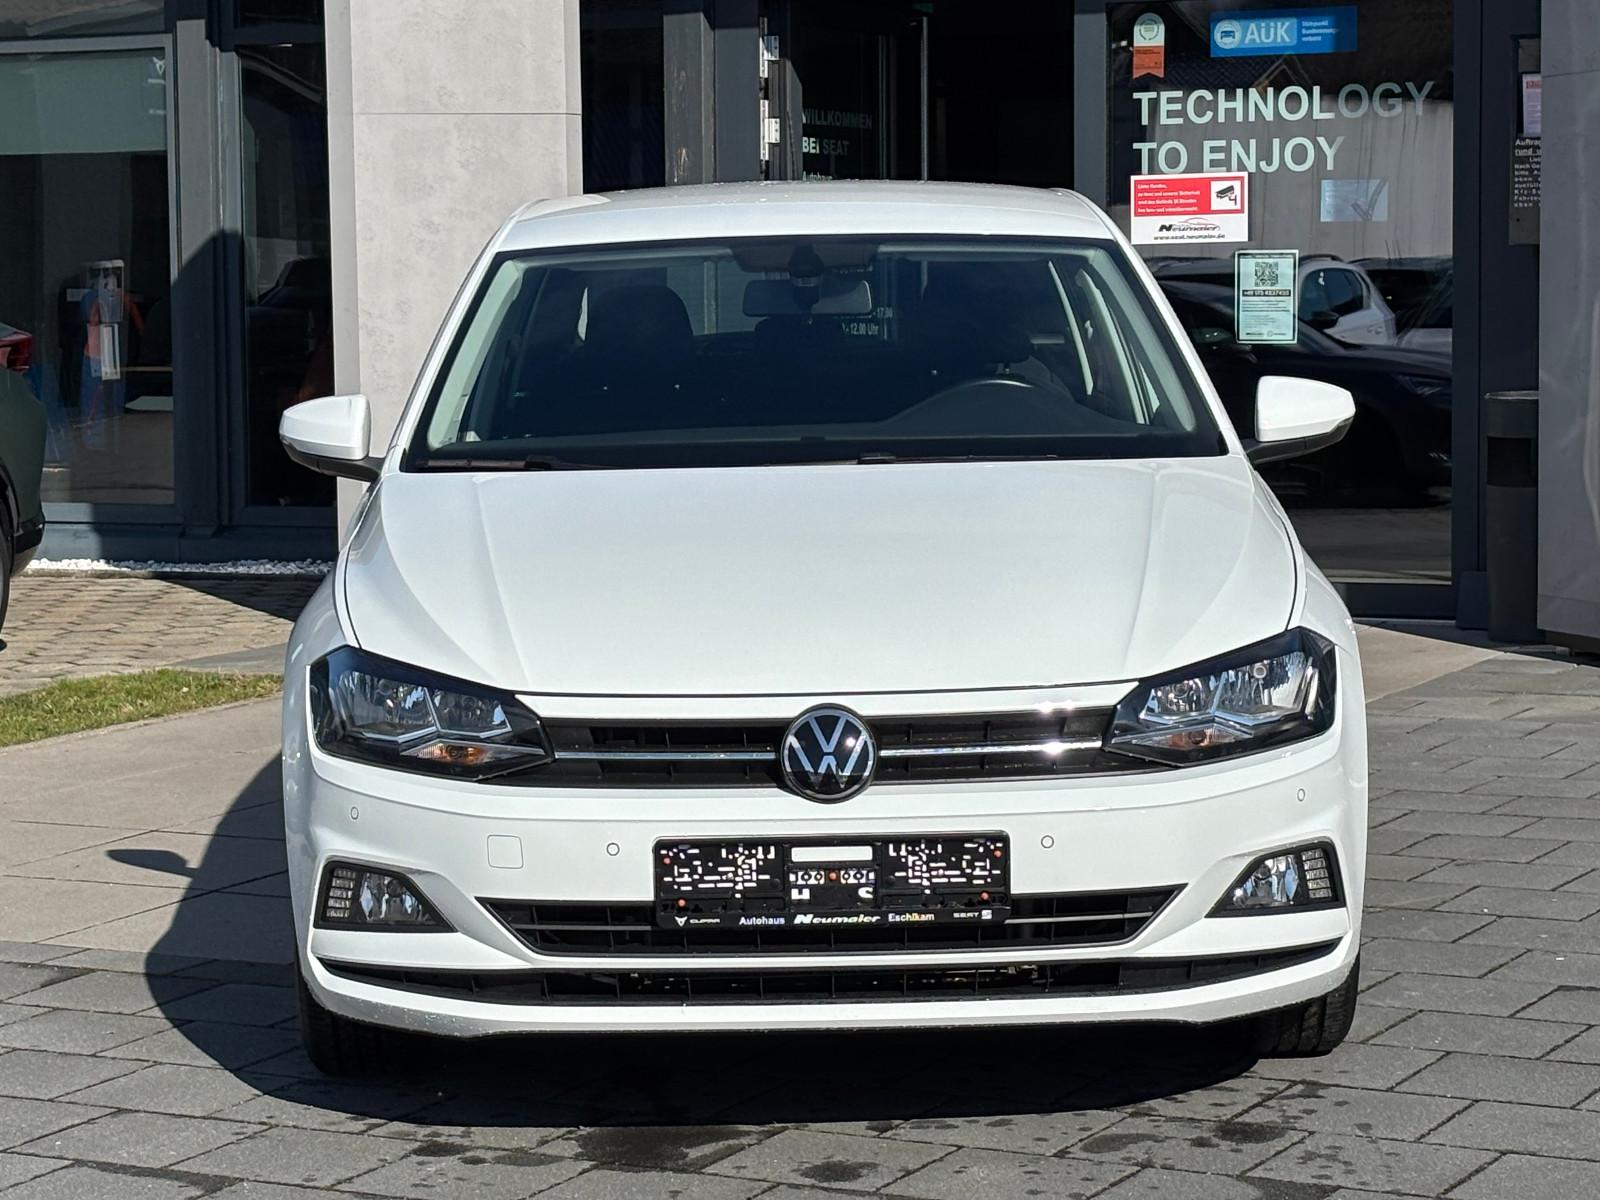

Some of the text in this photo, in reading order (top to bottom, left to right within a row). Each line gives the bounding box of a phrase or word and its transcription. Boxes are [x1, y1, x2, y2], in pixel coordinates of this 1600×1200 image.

[1132, 81, 1435, 126] TECHNOLOGY
[802, 107, 873, 129] WILLKOMMEN
[802, 136, 850, 156] BEI SEAT
[1132, 136, 1346, 174] TO ENJOY
[738, 915, 785, 926] Autohaus
[793, 914, 881, 925] Neumaier
